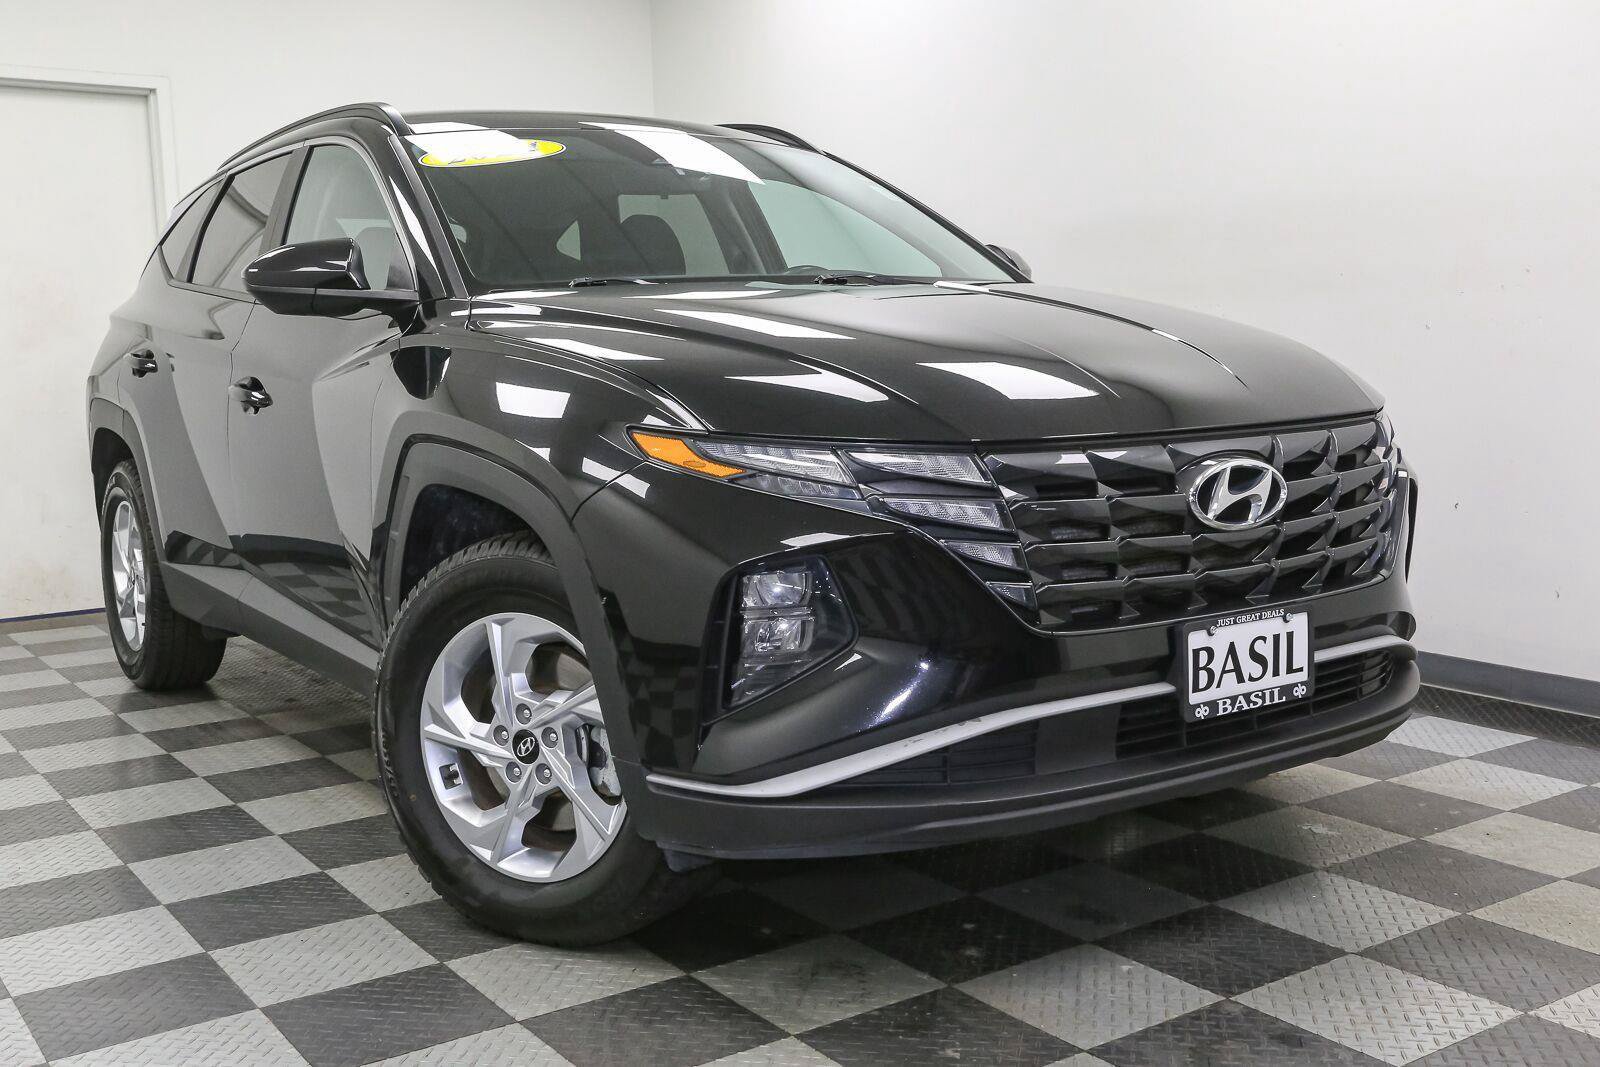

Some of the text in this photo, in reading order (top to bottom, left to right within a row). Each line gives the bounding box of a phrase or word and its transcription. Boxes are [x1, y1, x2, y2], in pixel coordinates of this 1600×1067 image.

[1217, 608, 1285, 627] JUST GREAT DEALS
[1192, 631, 1304, 694] BASIL
[1217, 687, 1285, 716] BASIL
